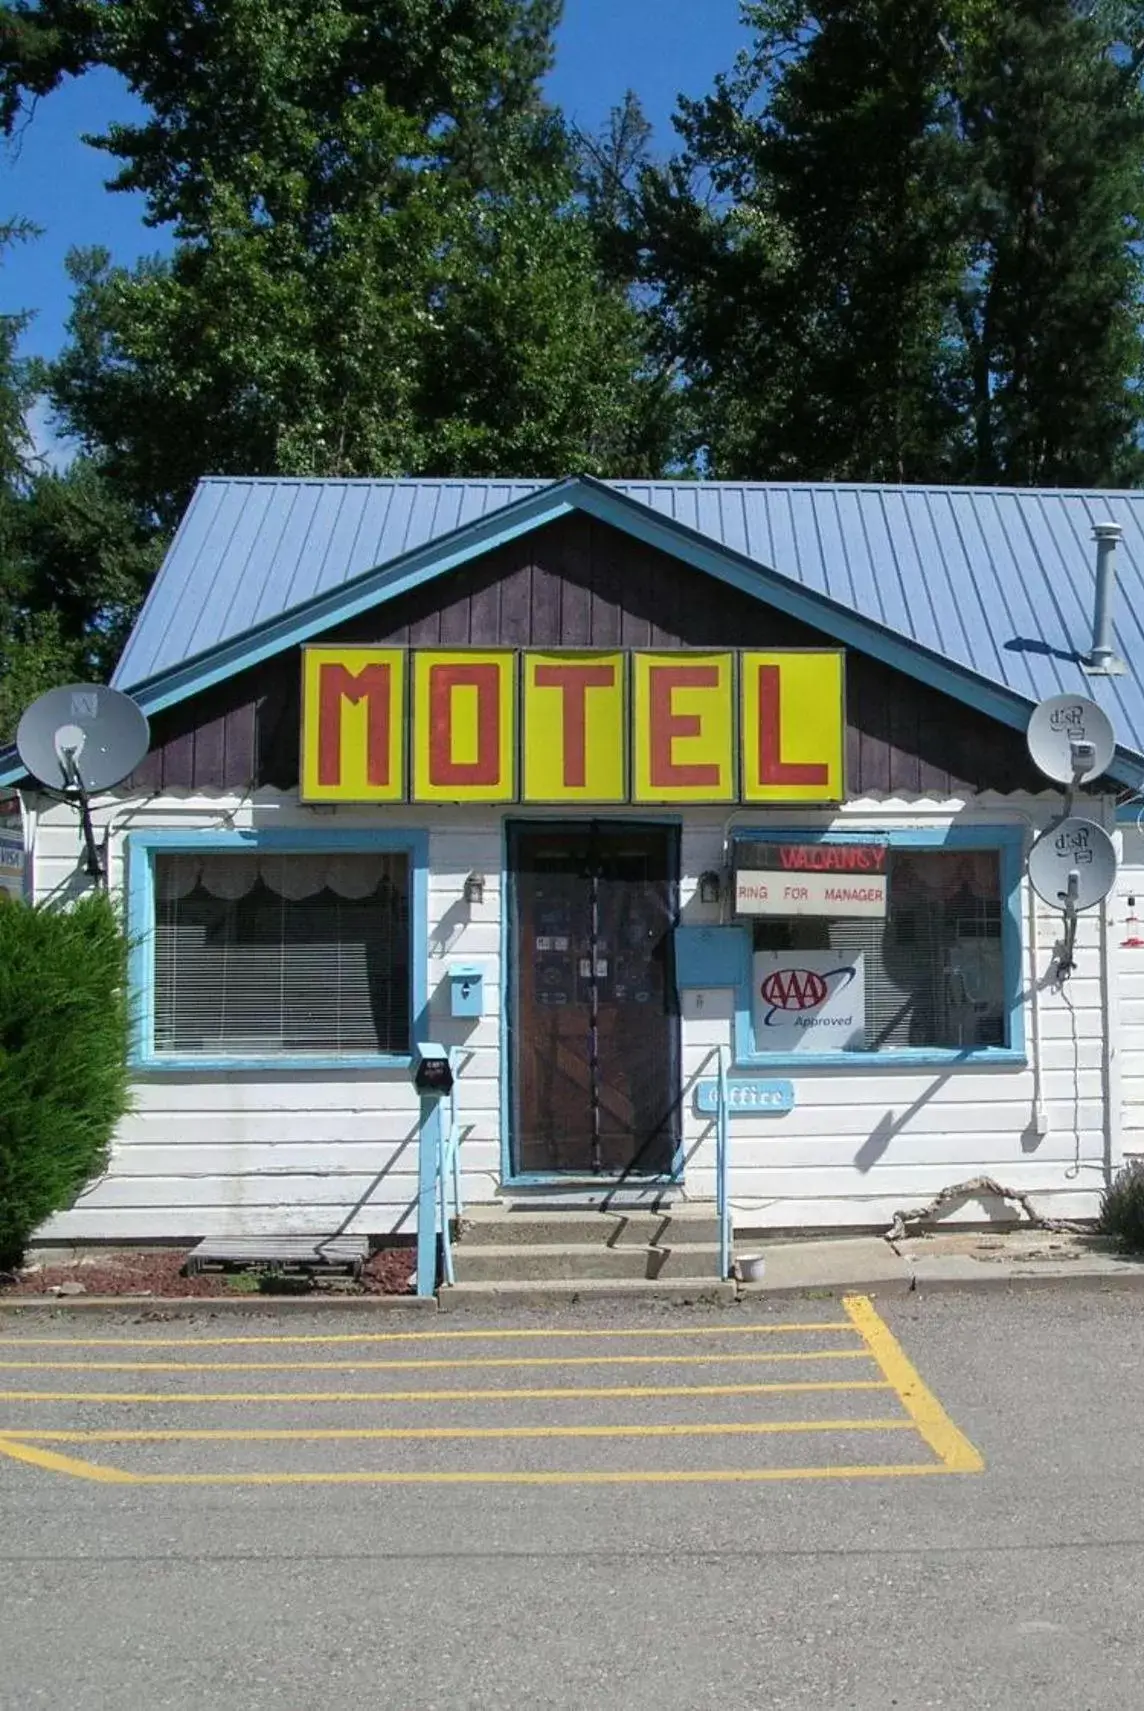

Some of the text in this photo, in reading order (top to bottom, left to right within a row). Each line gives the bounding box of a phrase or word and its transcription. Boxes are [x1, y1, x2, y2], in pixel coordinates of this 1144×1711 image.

[317, 662, 829, 787] MOTEL
[738, 886, 883, 902] RING FOR MANAGER
[764, 970, 825, 1010] AAA
[794, 1016, 853, 1028] Approved
